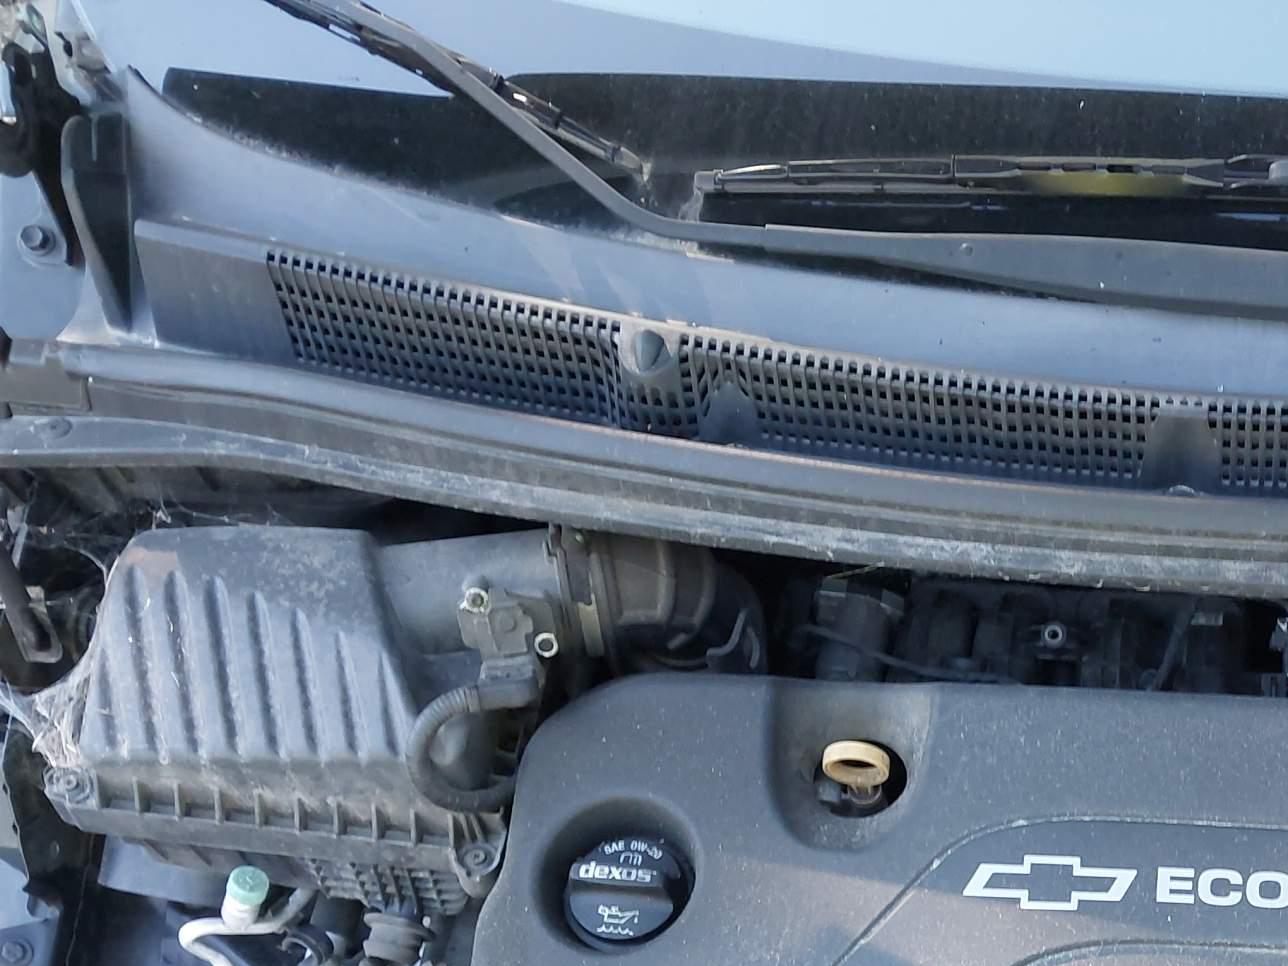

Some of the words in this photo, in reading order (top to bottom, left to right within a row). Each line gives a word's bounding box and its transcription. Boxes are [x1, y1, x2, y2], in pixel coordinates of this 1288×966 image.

[603, 840, 625, 855] SAE
[630, 840, 663, 860] 0W-20
[579, 861, 652, 882] dexos
